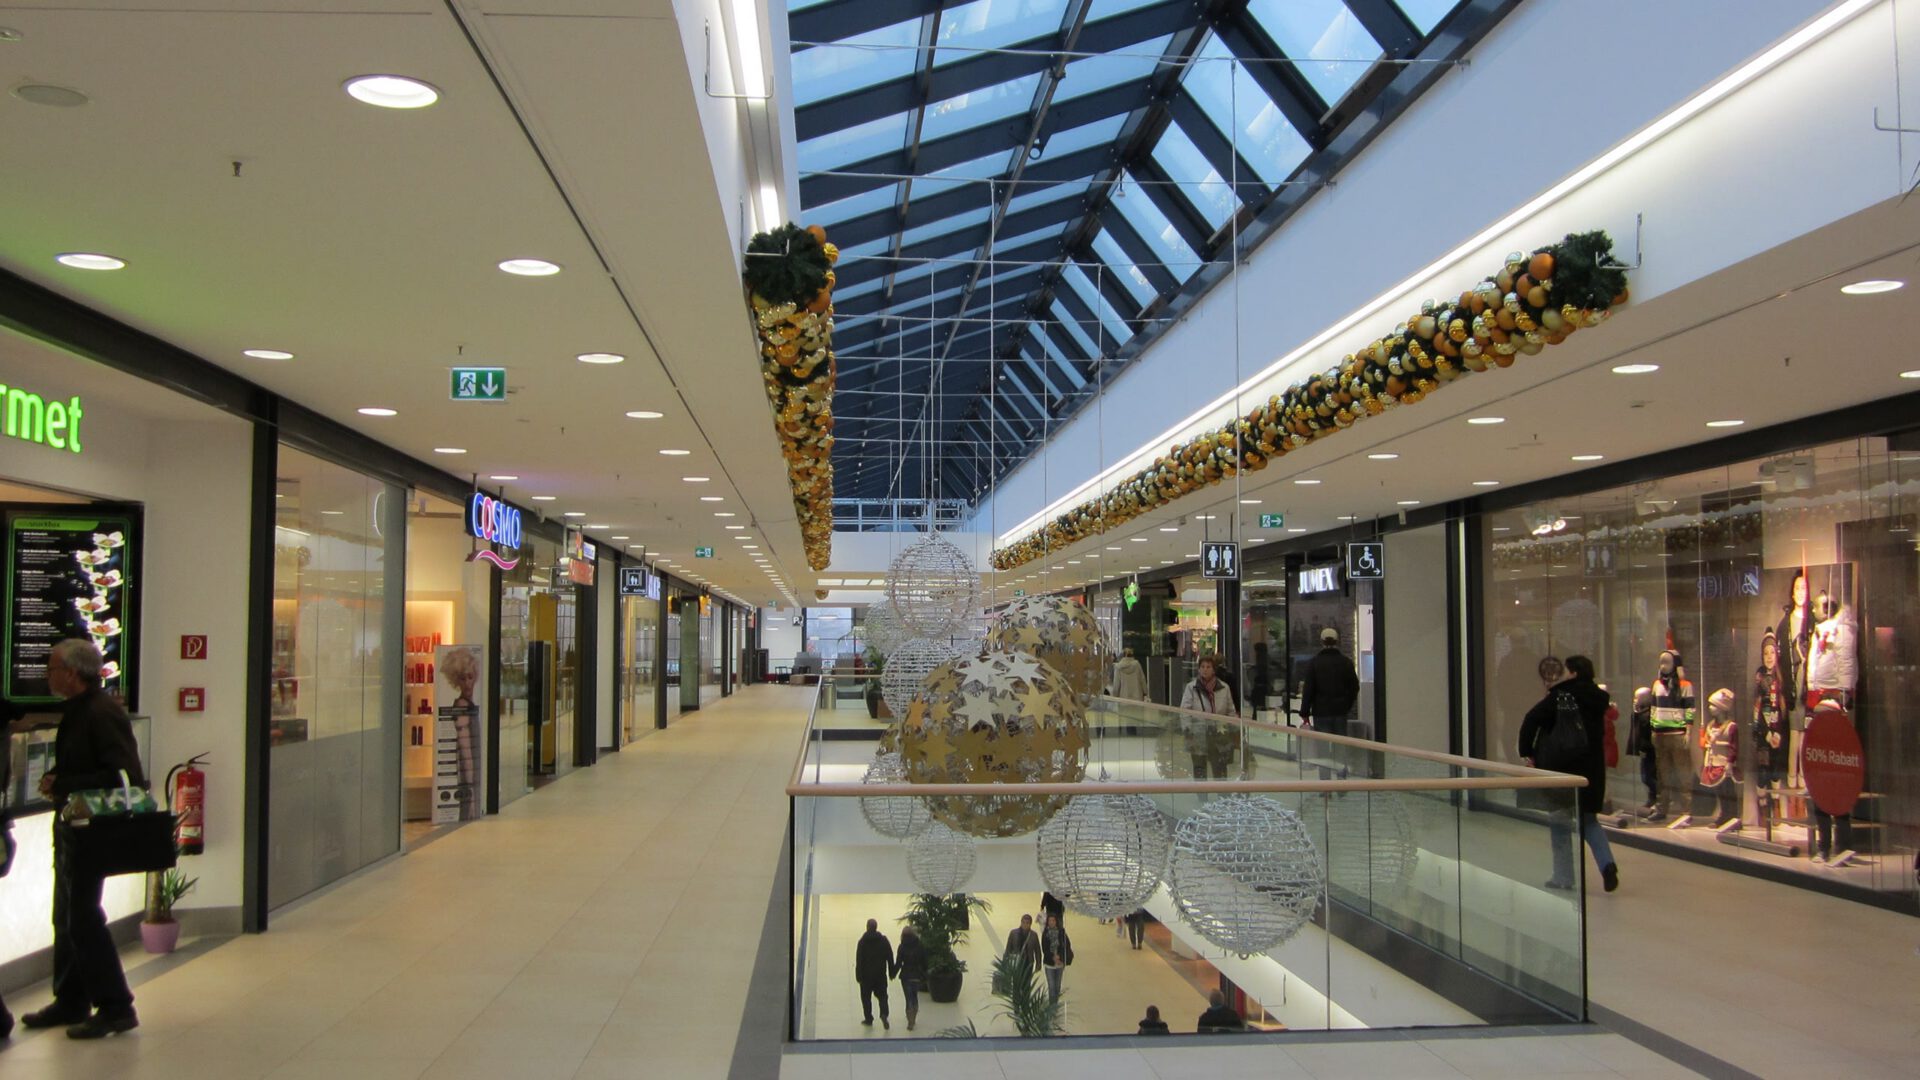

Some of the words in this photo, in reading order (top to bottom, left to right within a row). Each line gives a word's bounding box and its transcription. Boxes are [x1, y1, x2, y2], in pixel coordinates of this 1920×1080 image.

[473, 492, 521, 550] COSMO
[1298, 567, 1334, 594] JUMEX
[1805, 747, 1827, 763] 50%
[1829, 750, 1859, 768] Rabatt
